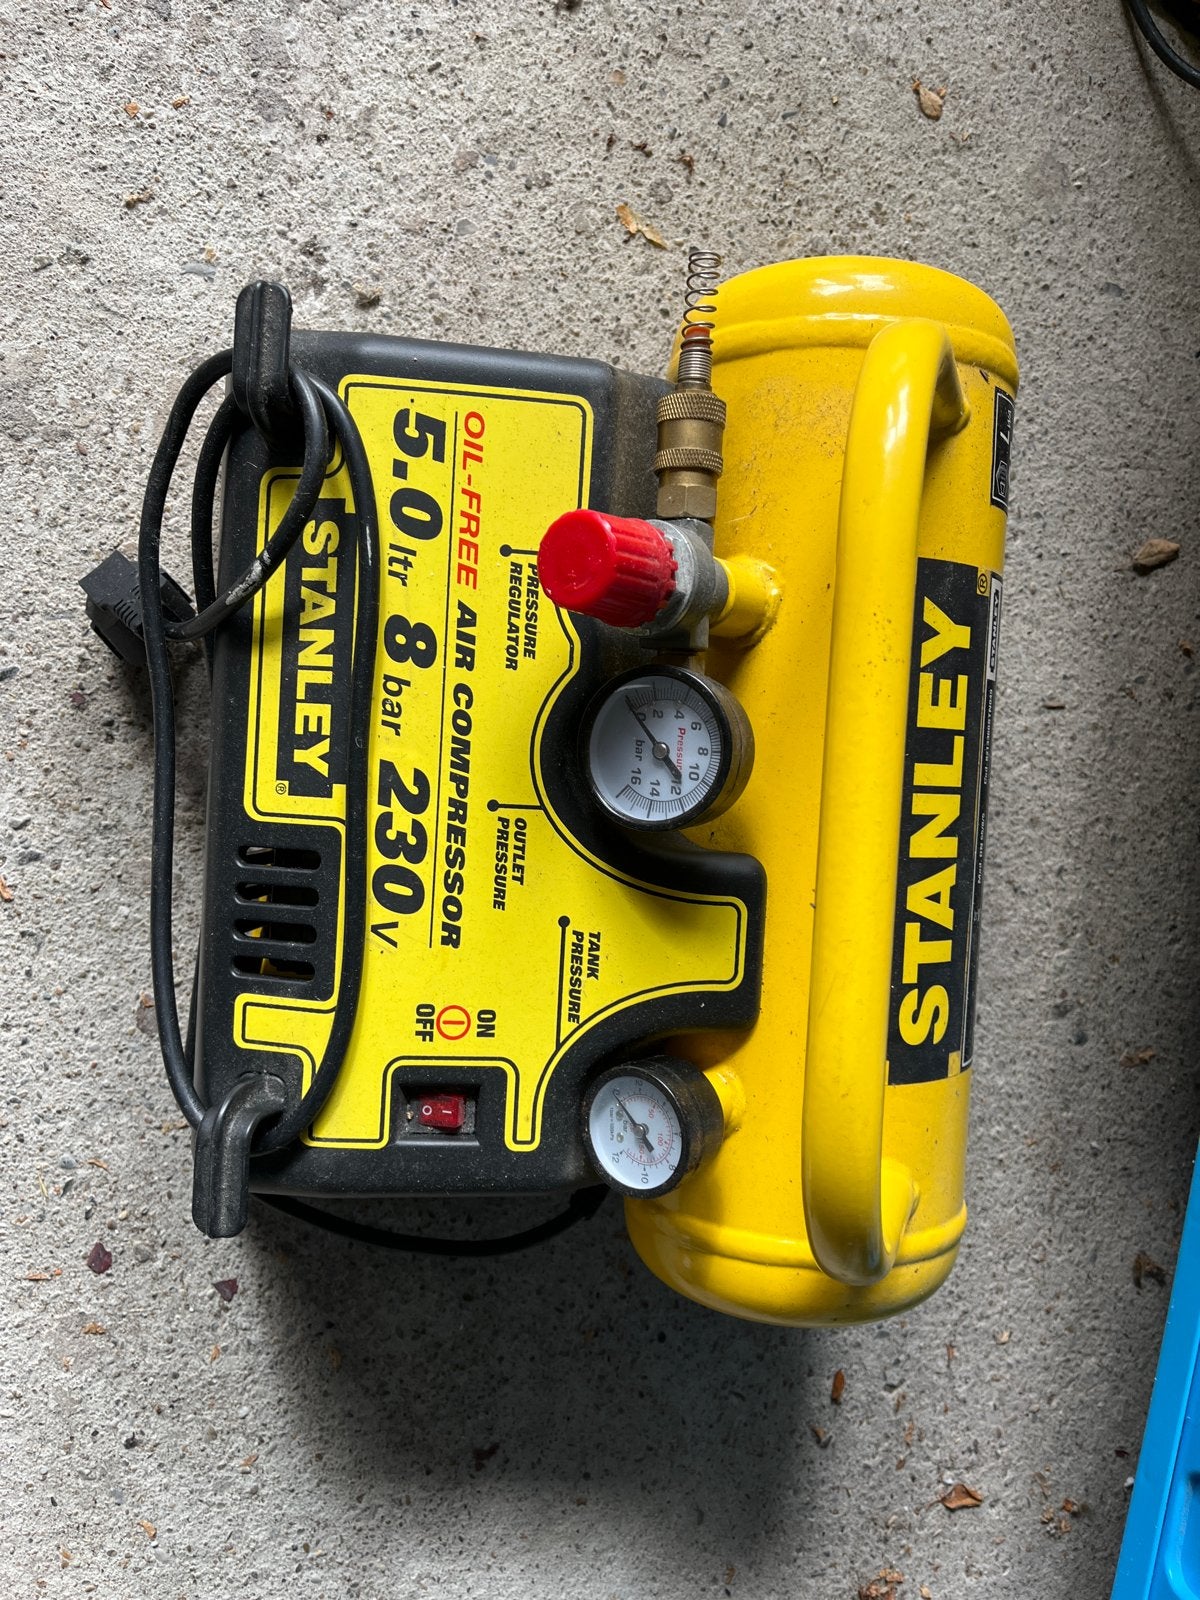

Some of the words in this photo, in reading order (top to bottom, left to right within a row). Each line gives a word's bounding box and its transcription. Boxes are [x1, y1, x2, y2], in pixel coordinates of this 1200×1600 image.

[389, 407, 447, 540] 5.0
[456, 411, 485, 590] OIL-FREE
[388, 543, 417, 587] ltr
[454, 599, 477, 672] AIR
[505, 561, 523, 671] REGULATOR
[523, 562, 540, 660] PRESSURE
[990, 595, 999, 668] STANLEY
[293, 520, 340, 778] STANLEY
[384, 614, 437, 669] 8
[381, 673, 411, 736] bar
[652, 709, 664, 719] 2
[674, 710, 685, 720] 4
[690, 721, 702, 731] 6
[634, 739, 646, 761] bar
[676, 727, 686, 770] Pressur
[688, 763, 700, 781] 10
[697, 746, 709, 757] 8
[630, 768, 642, 786] 16
[649, 779, 661, 797] 14
[670, 779, 682, 796] 12
[372, 758, 431, 915] 230
[440, 682, 474, 949] COMPRESSOR
[898, 596, 972, 1046] STANLEY
[493, 816, 510, 911] PRESSURE
[511, 817, 528, 886] OUTLET
[567, 929, 585, 1024] PRESSURE
[587, 931, 601, 980] TANK
[415, 1003, 435, 1042] OFF
[476, 1009, 497, 1038] ON
[611, 1153, 620, 1164] 12
[641, 1172, 649, 1184] 10
